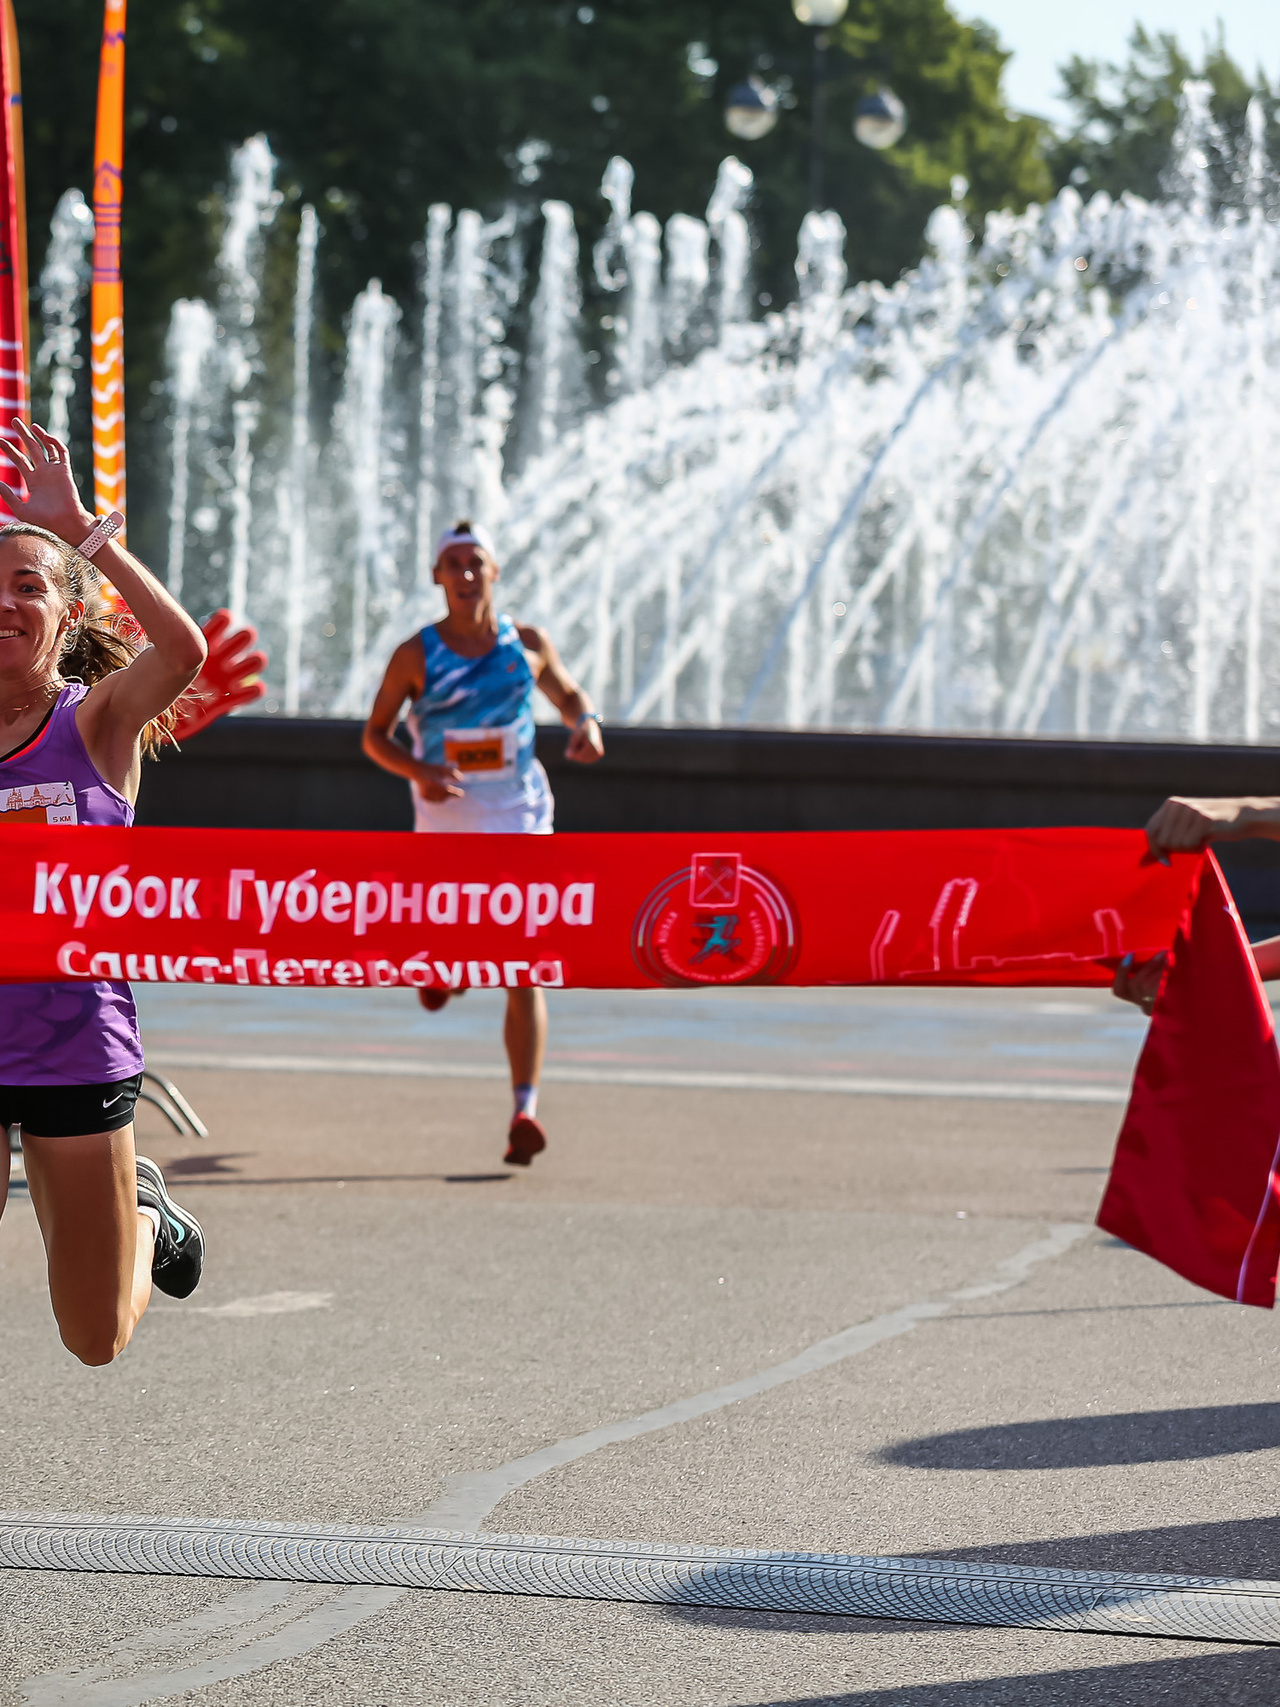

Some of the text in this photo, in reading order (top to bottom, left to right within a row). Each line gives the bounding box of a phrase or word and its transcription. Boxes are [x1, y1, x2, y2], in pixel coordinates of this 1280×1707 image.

[33, 862, 595, 937] Кубок Губернатора
[56, 940, 565, 988] Санкт-Петербурга
